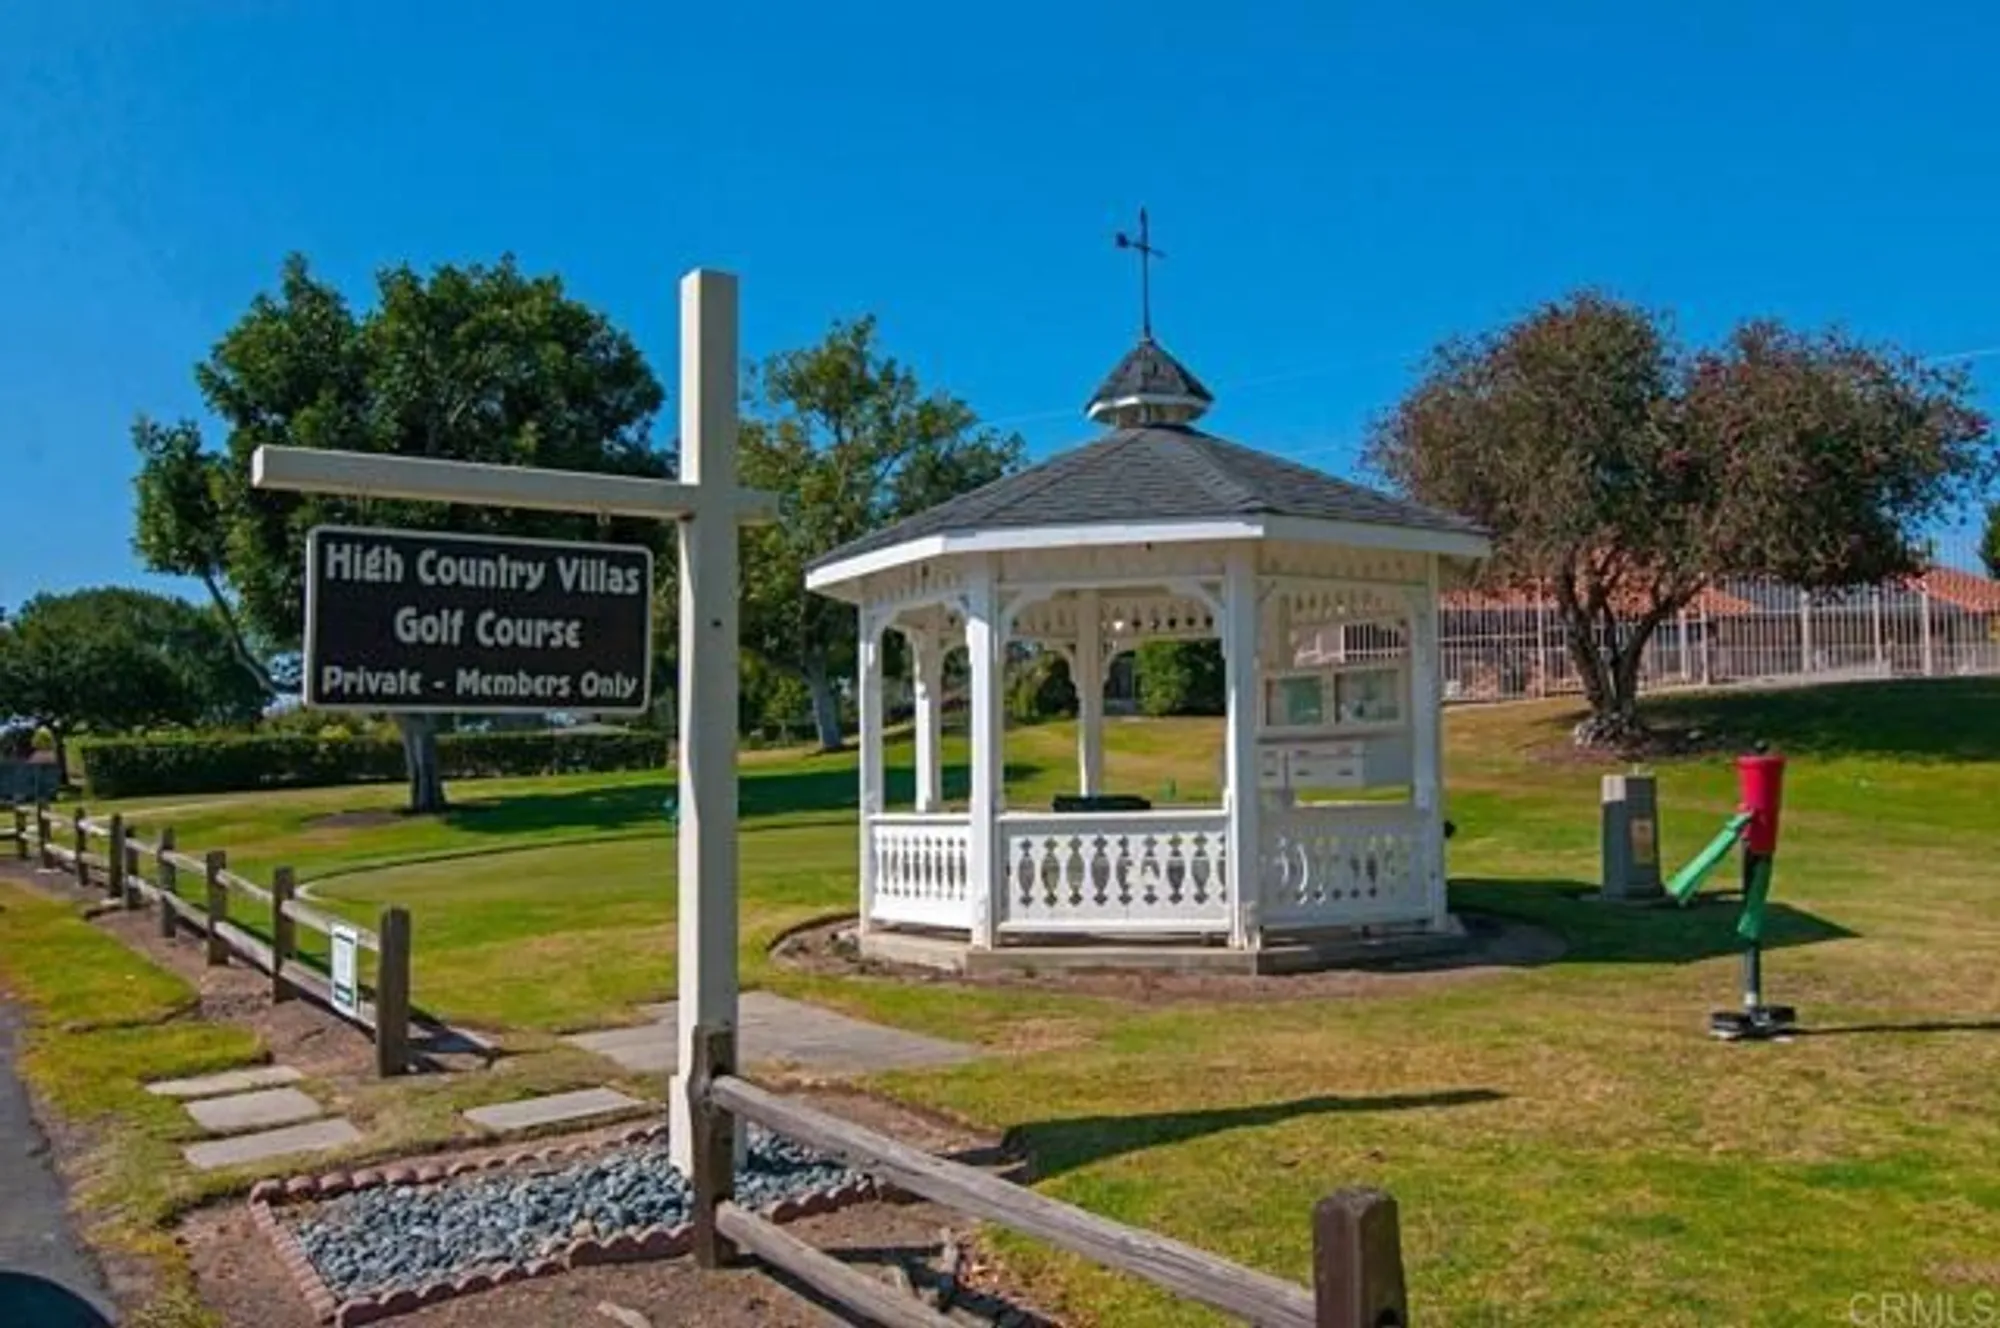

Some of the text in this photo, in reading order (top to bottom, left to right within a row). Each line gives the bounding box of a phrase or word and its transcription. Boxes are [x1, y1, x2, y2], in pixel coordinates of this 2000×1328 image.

[326, 543, 640, 594] High Country Villas
[394, 606, 582, 649] Golf Course
[321, 665, 422, 695] Private
[455, 668, 571, 697] Members
[580, 671, 638, 699] Only
